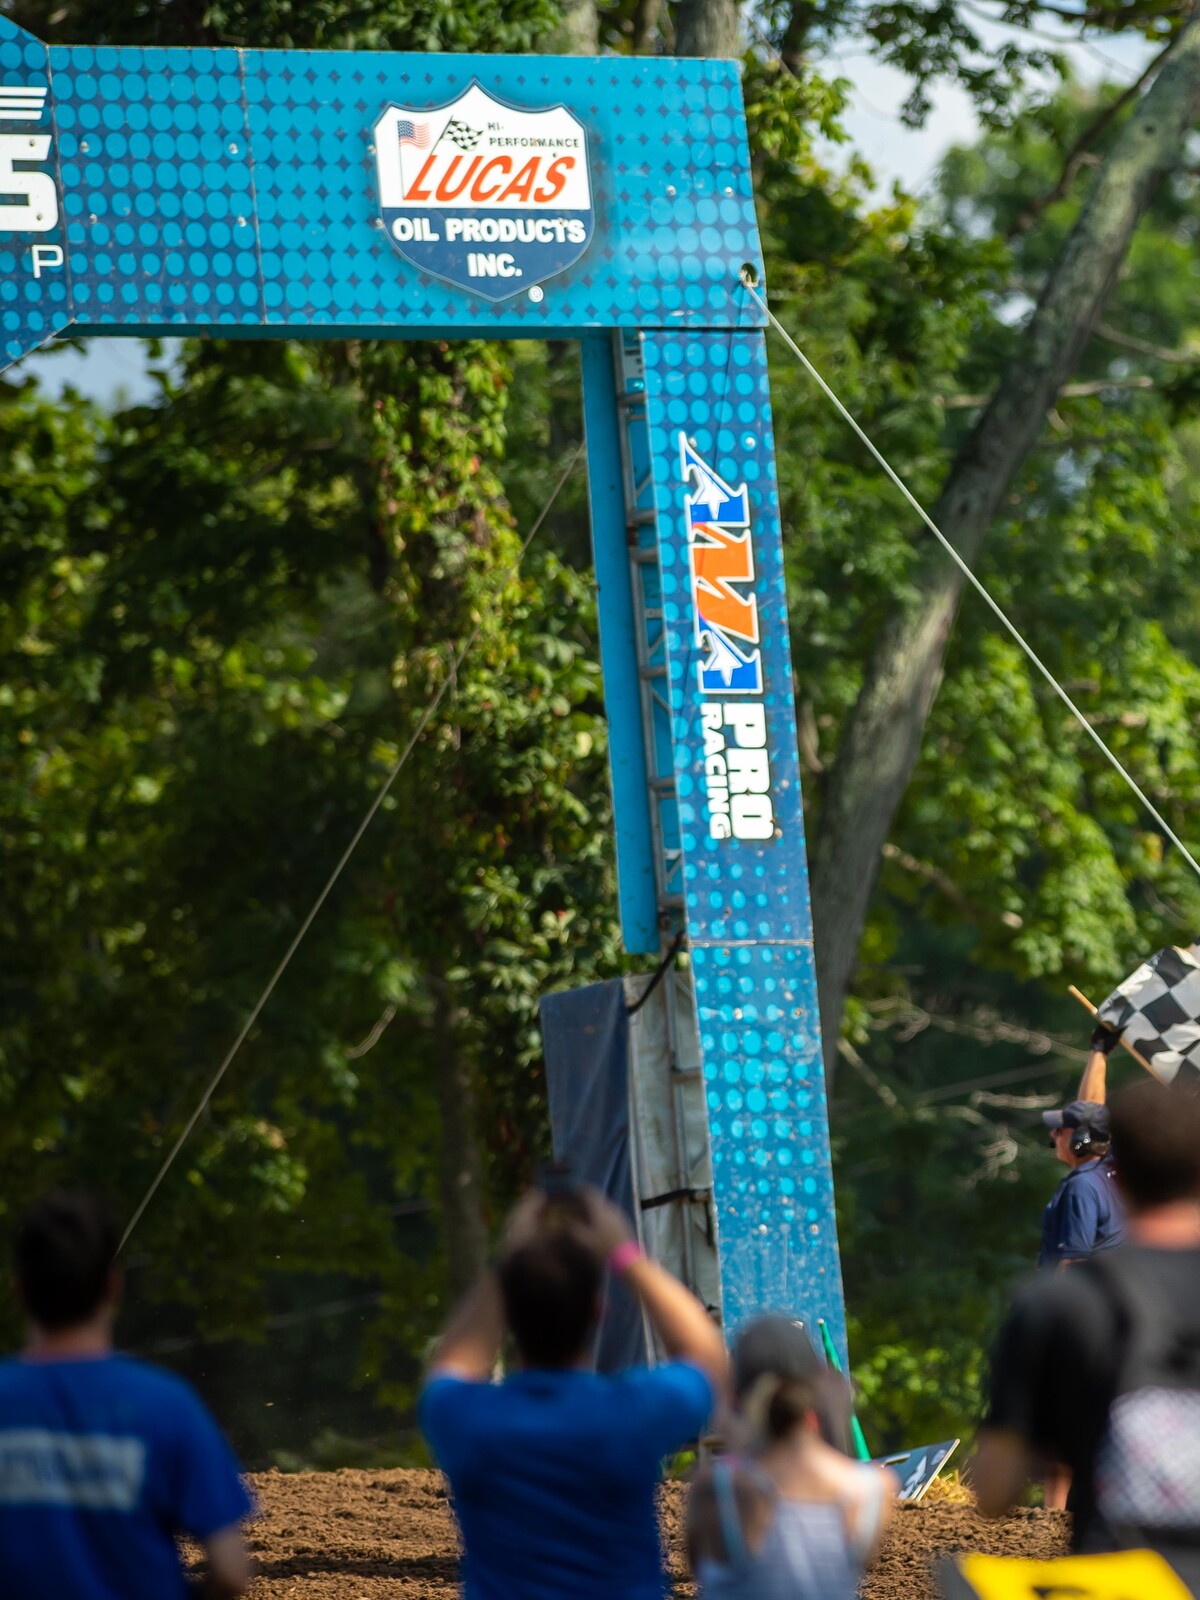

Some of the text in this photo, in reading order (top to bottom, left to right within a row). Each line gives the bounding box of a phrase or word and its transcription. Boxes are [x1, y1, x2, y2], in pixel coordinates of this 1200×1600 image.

[489, 137, 580, 148] PERFORMANCE
[403, 154, 576, 203] LUCAS
[392, 217, 587, 243] OIL PRODUCTS
[467, 252, 523, 277] INC.
[700, 702, 730, 839] RACING
[723, 702, 774, 839] PRO
